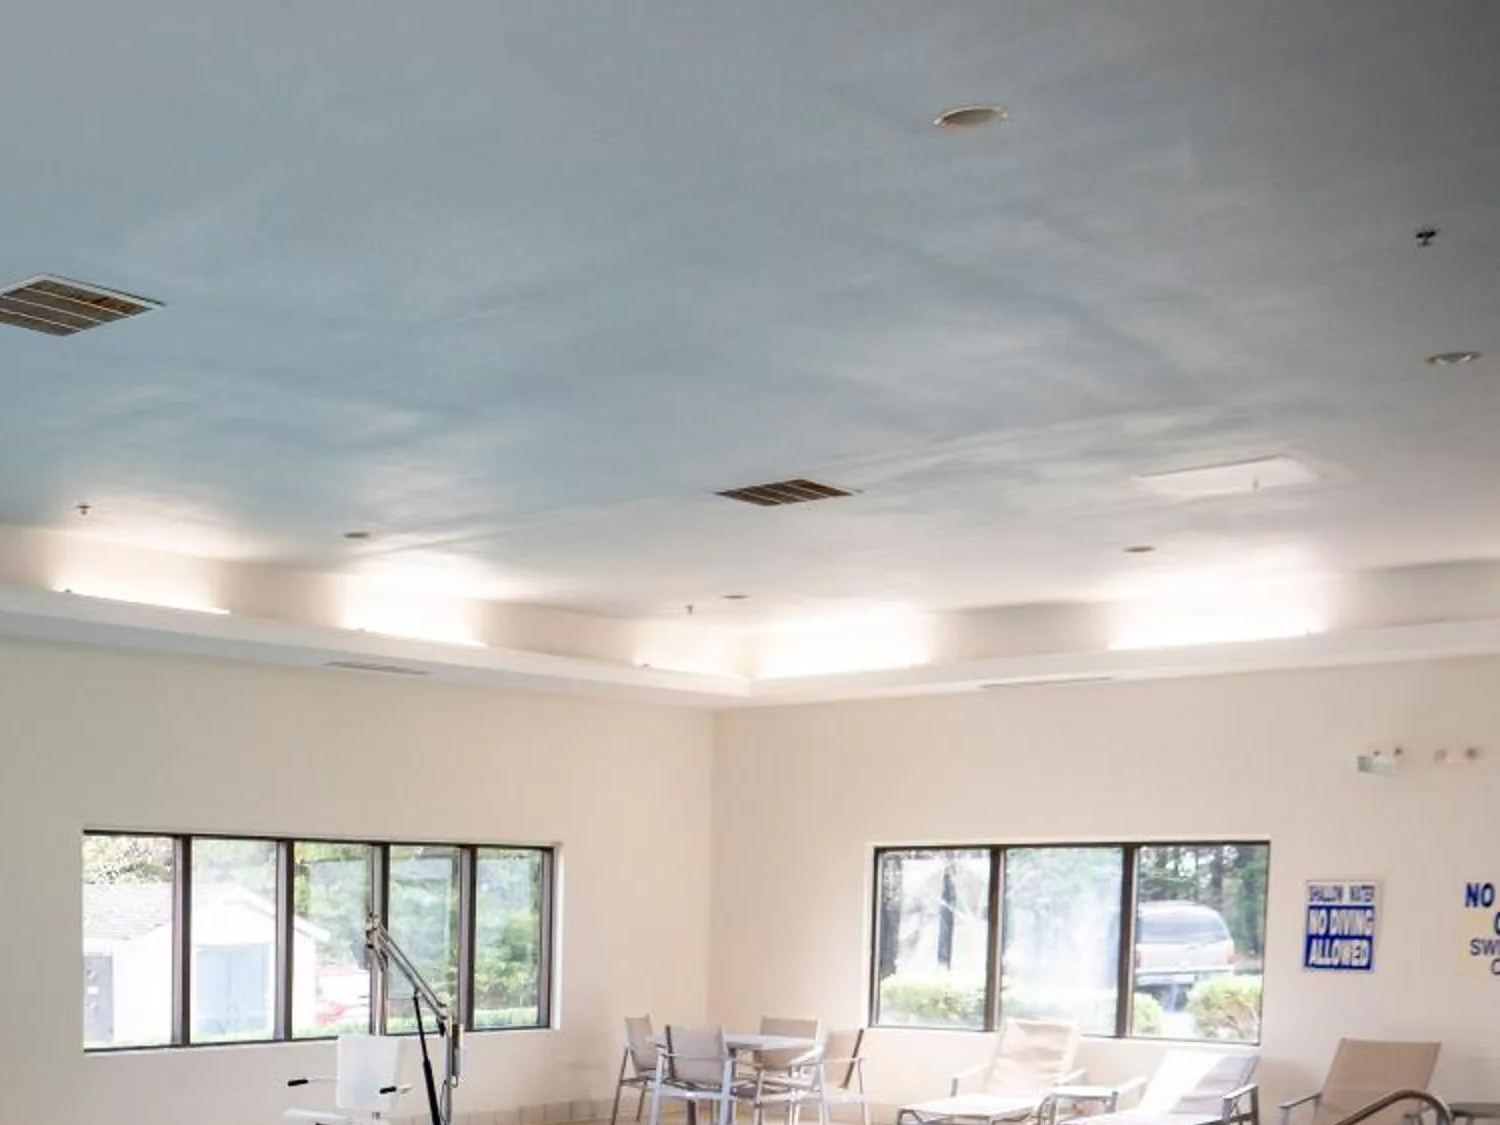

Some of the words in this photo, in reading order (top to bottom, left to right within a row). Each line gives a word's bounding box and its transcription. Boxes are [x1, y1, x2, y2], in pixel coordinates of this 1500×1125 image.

[1465, 882, 1495, 908] NO
[1308, 908, 1327, 935] NO
[1329, 908, 1373, 936] DIVING
[1309, 939, 1369, 967] ALLOWED
